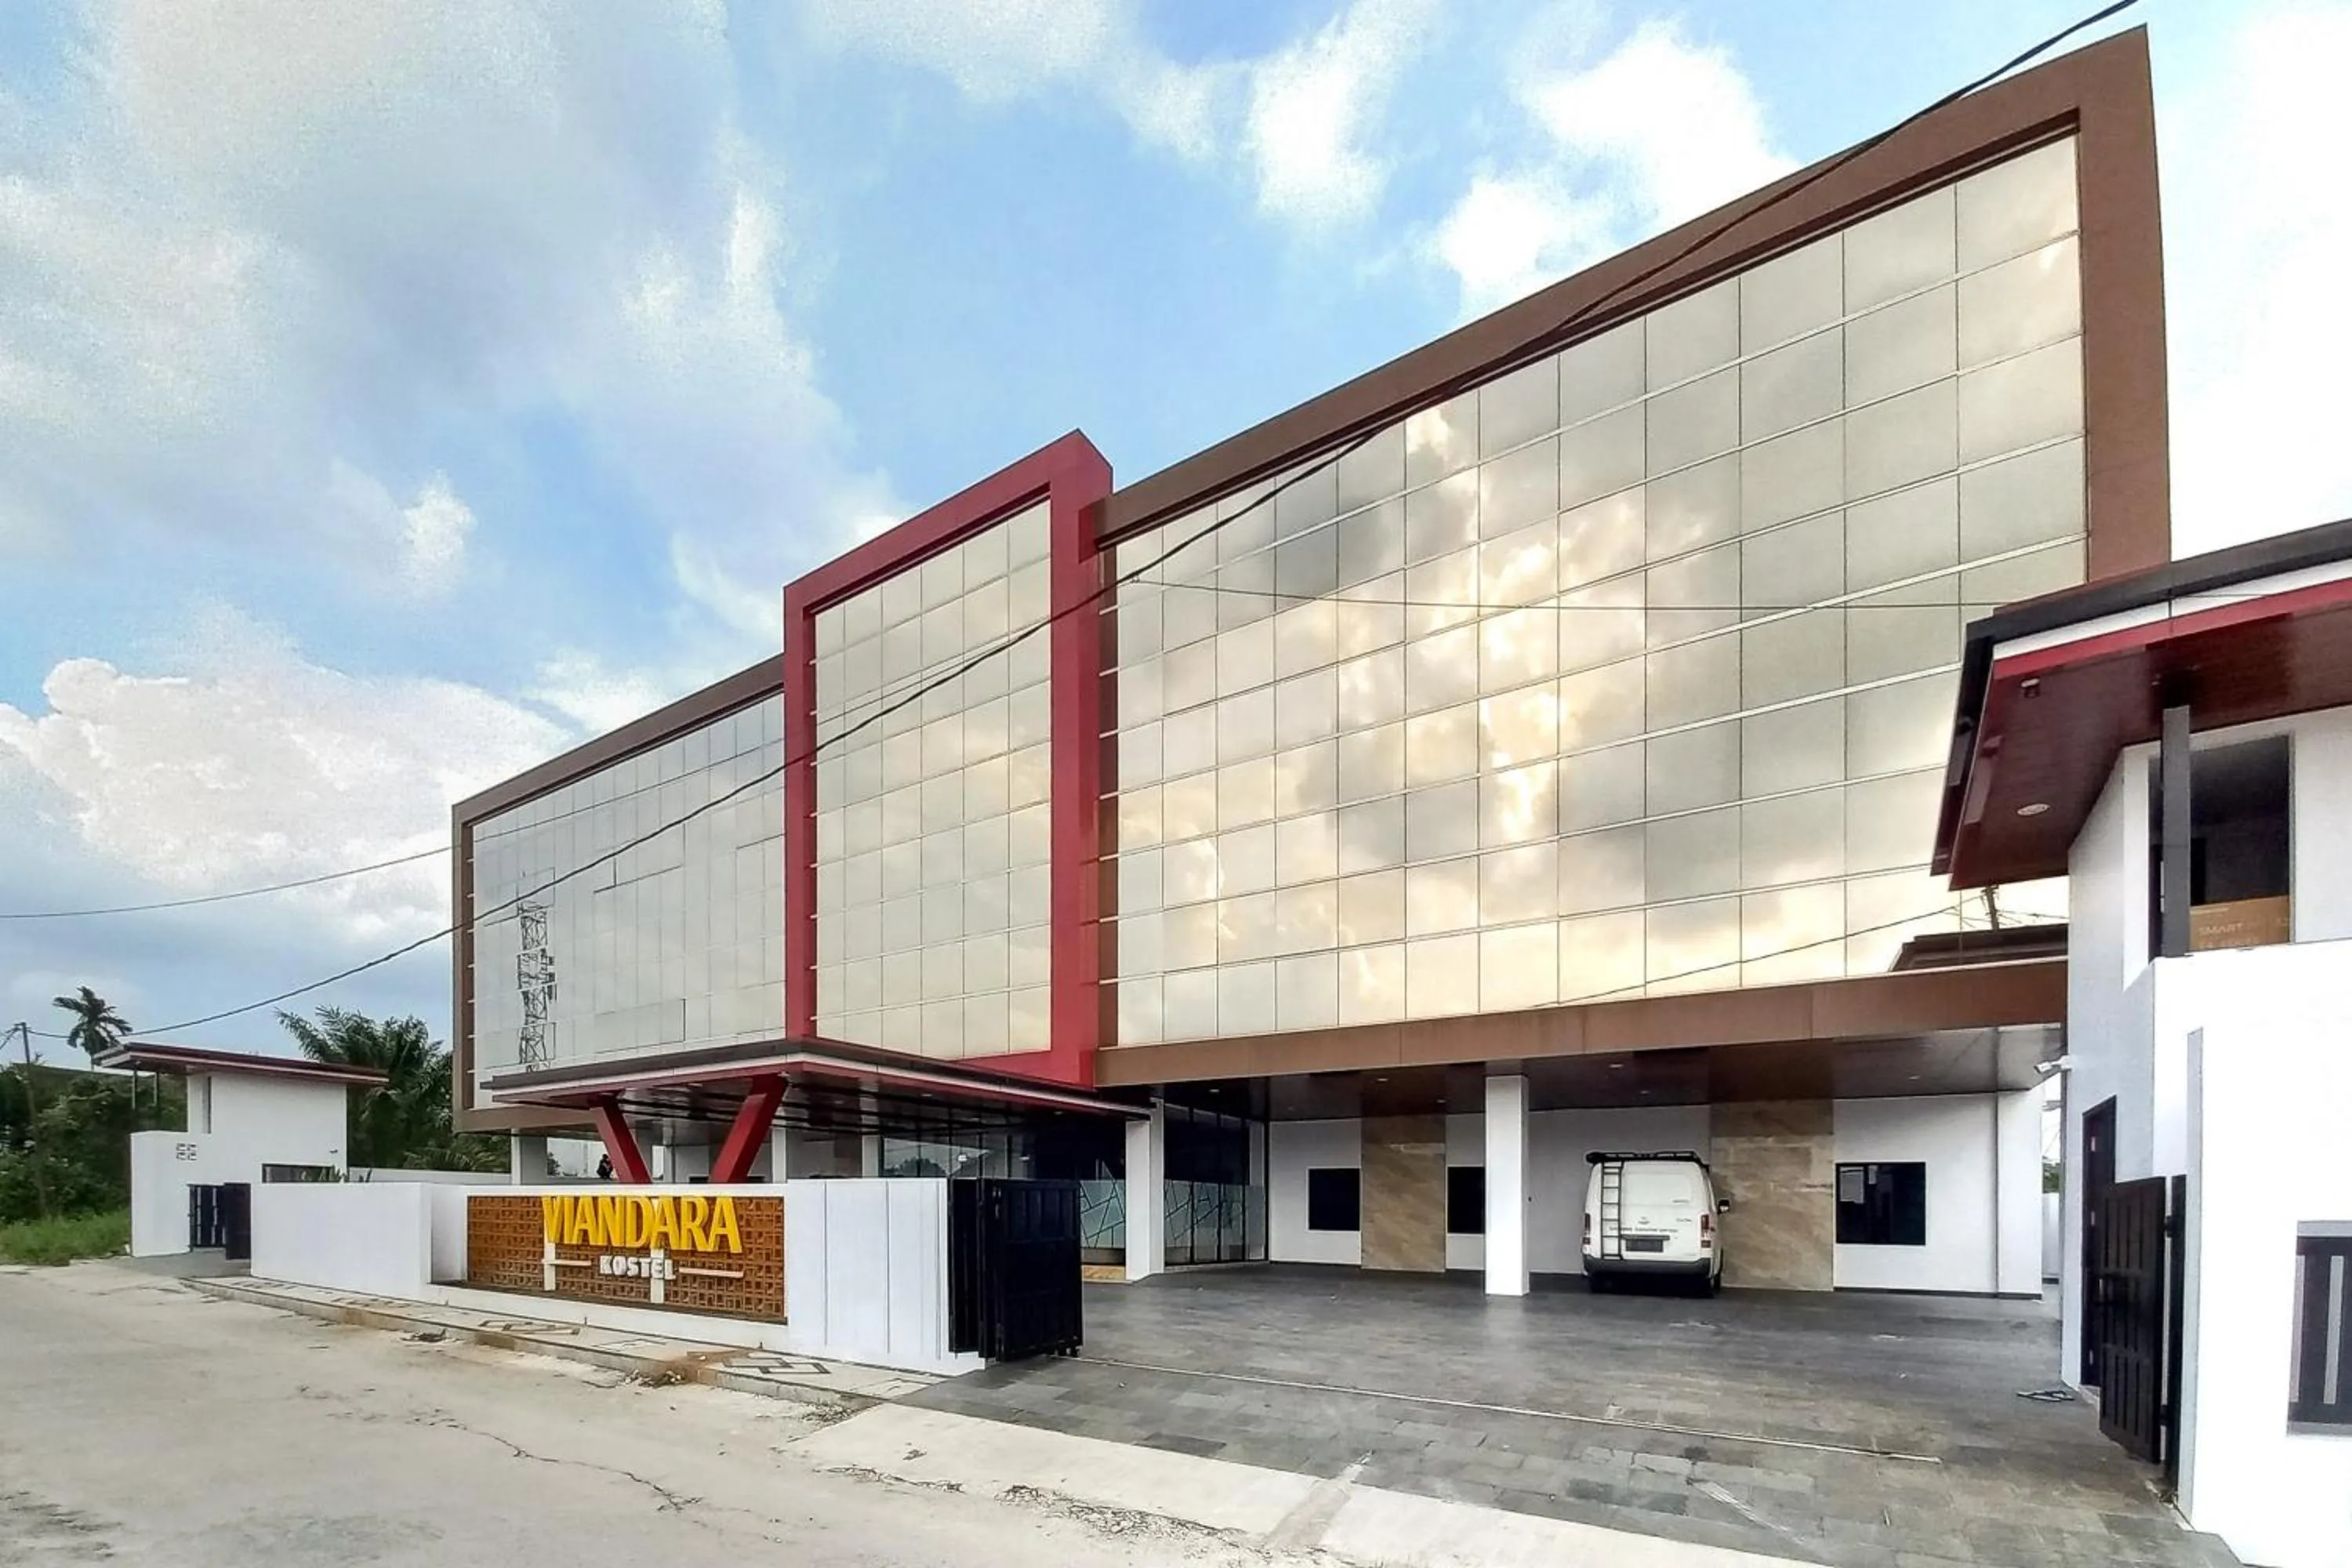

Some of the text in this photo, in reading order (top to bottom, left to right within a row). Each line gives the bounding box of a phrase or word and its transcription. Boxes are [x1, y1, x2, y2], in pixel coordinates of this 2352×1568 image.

[2198, 923, 2244, 935] SMART
[541, 1195, 742, 1254] VIANDARA
[600, 1255, 677, 1280] KOSTEL
